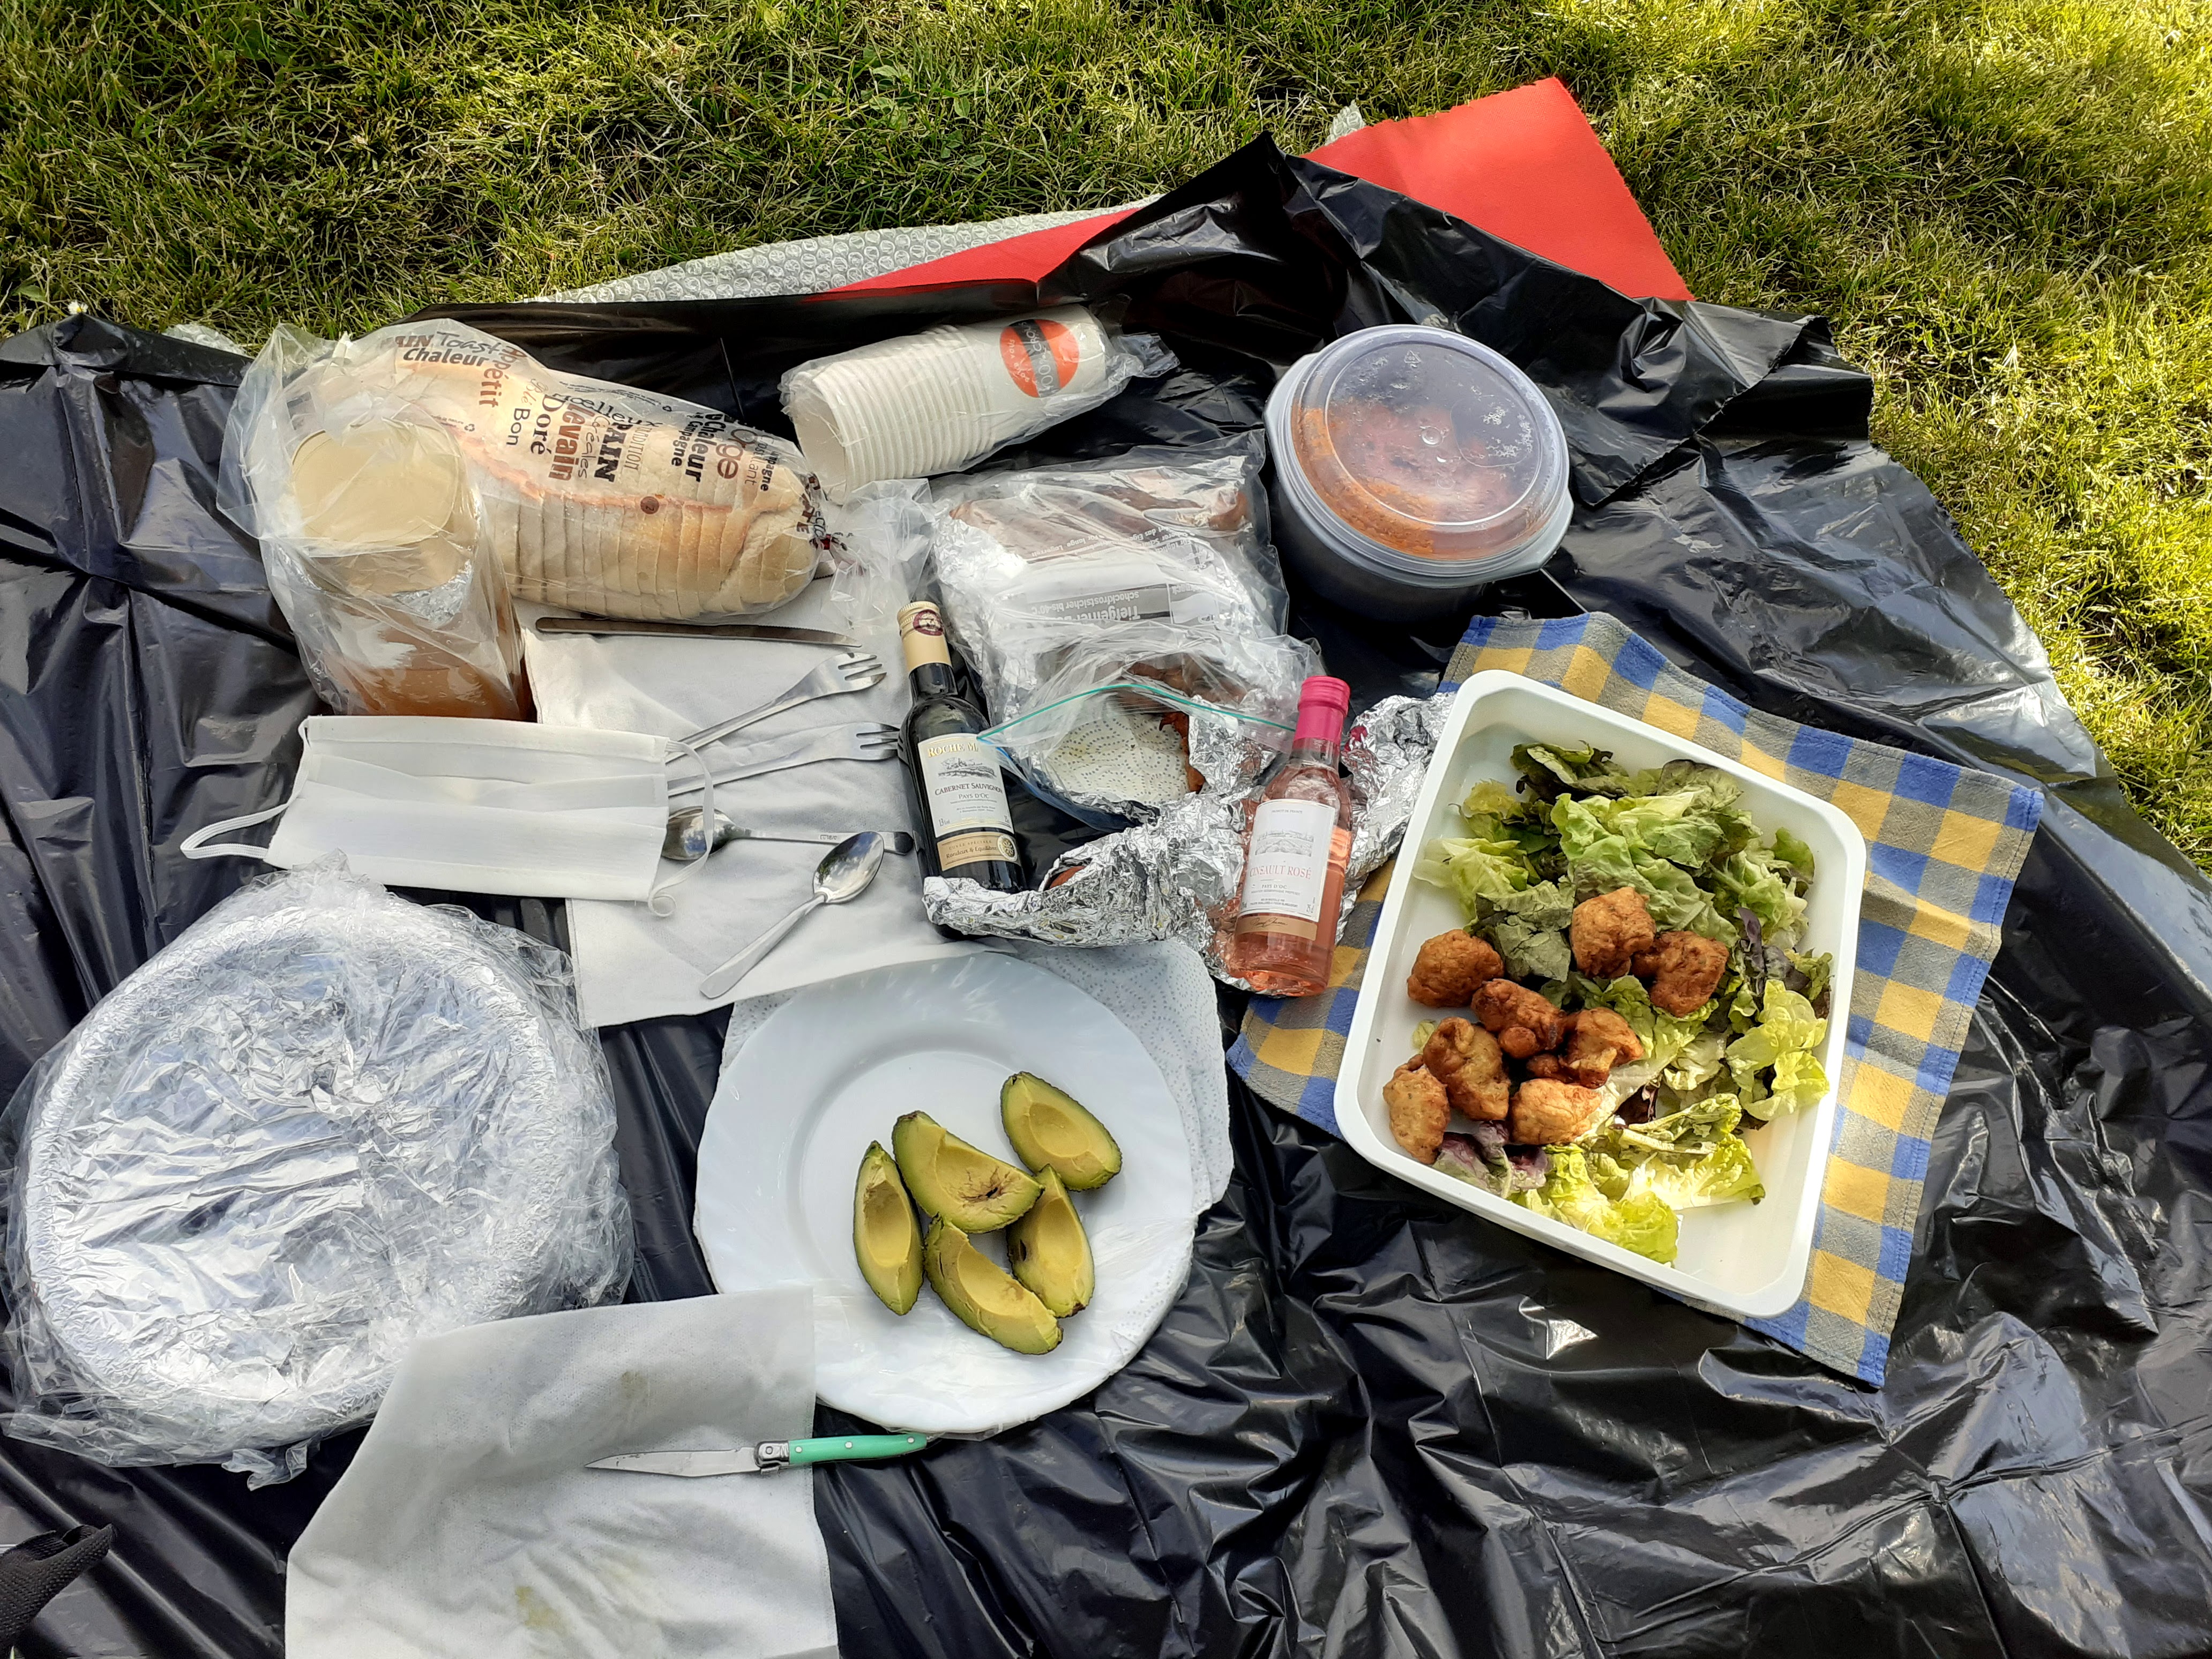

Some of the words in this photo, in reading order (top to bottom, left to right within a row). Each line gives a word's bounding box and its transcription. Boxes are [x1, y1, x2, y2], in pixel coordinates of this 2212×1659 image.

[437, 331, 502, 354] Toast
[403, 348, 490, 367] Chaleur
[479, 345, 527, 408] Appétit
[506, 408, 530, 446] Bon
[530, 394, 566, 454] Doré
[594, 422, 633, 482] PAIN
[685, 421, 727, 483] Chaleur
[715, 429, 758, 479] Orge
[1065, 591, 1140, 610] schockfrostsicher
[928, 743, 965, 757] ROCHE
[935, 783, 969, 796] CABERNET
[972, 783, 1003, 794] SAUVIGNON
[946, 849, 968, 858] Rondeur
[1250, 865, 1286, 877] CINSAULT
[1287, 865, 1311, 879] ROSÉ
